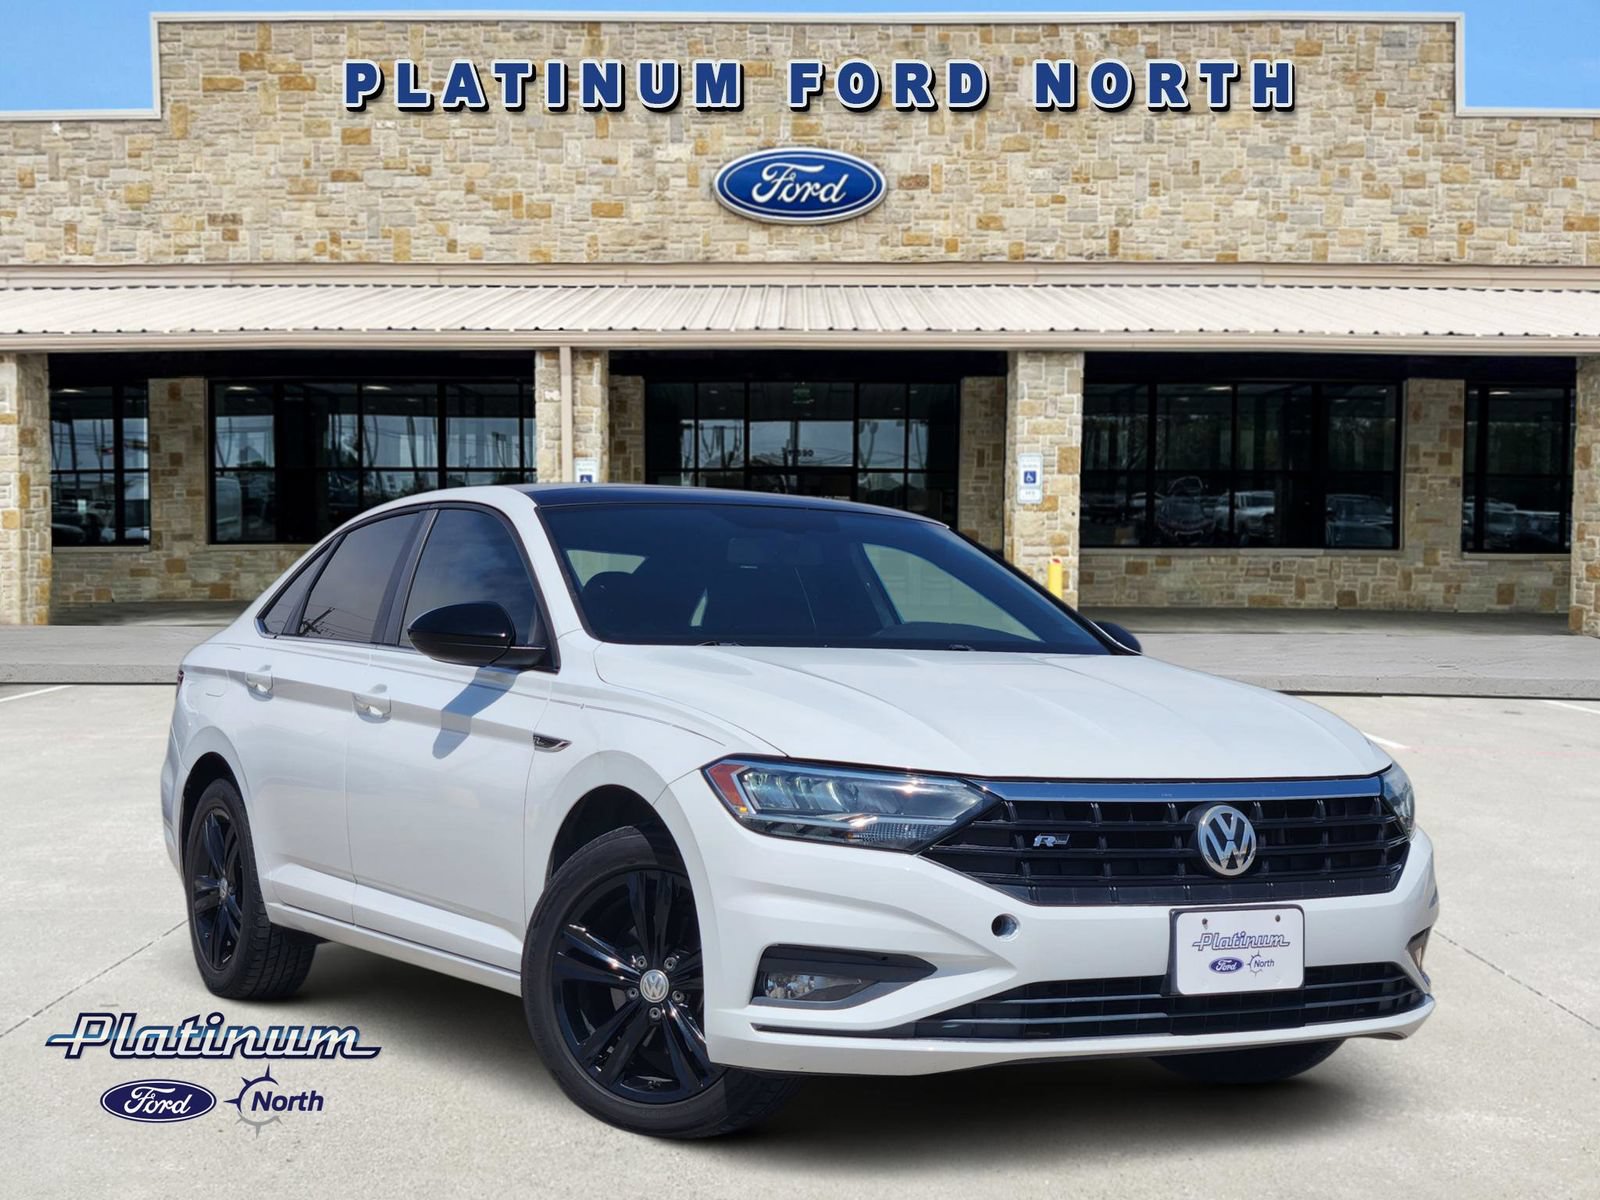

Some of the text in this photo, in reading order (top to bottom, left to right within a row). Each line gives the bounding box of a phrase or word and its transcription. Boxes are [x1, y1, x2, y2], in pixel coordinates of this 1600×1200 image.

[343, 59, 1295, 112] PLATINUM FORD NORTH
[750, 162, 848, 205] Ford
[1192, 931, 1290, 951] Platinum
[1215, 959, 1237, 971] Ford
[1253, 958, 1275, 969] North
